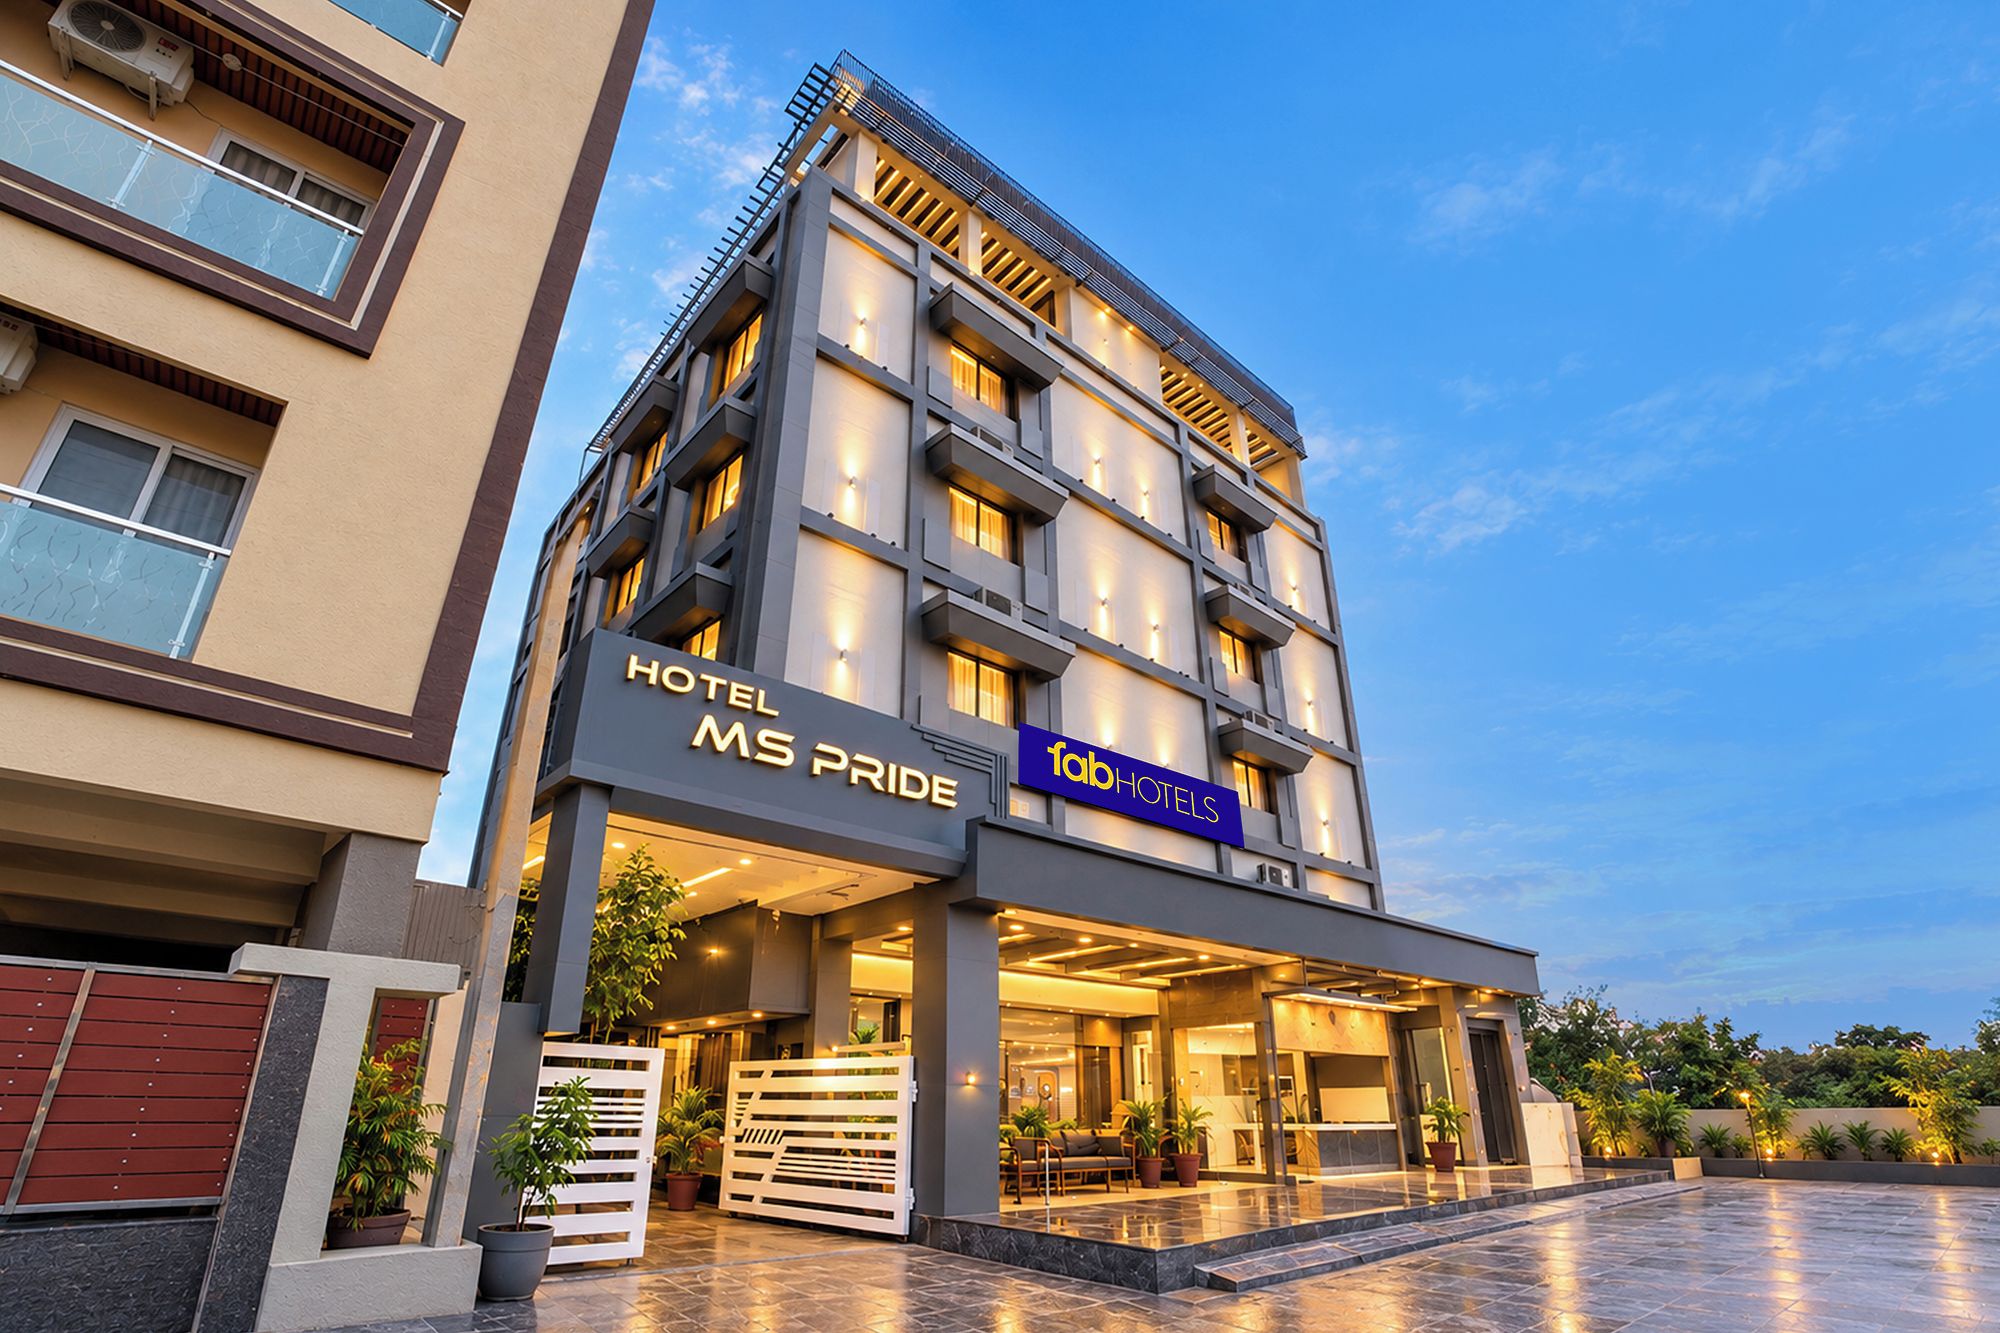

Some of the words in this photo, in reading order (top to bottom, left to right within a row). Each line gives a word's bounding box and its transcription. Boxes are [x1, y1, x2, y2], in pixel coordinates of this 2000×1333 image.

[626, 653, 780, 717] HOTEL
[690, 714, 796, 767] MS
[811, 742, 959, 808] PRIDE
[1047, 741, 1219, 823] fabHOTELS
